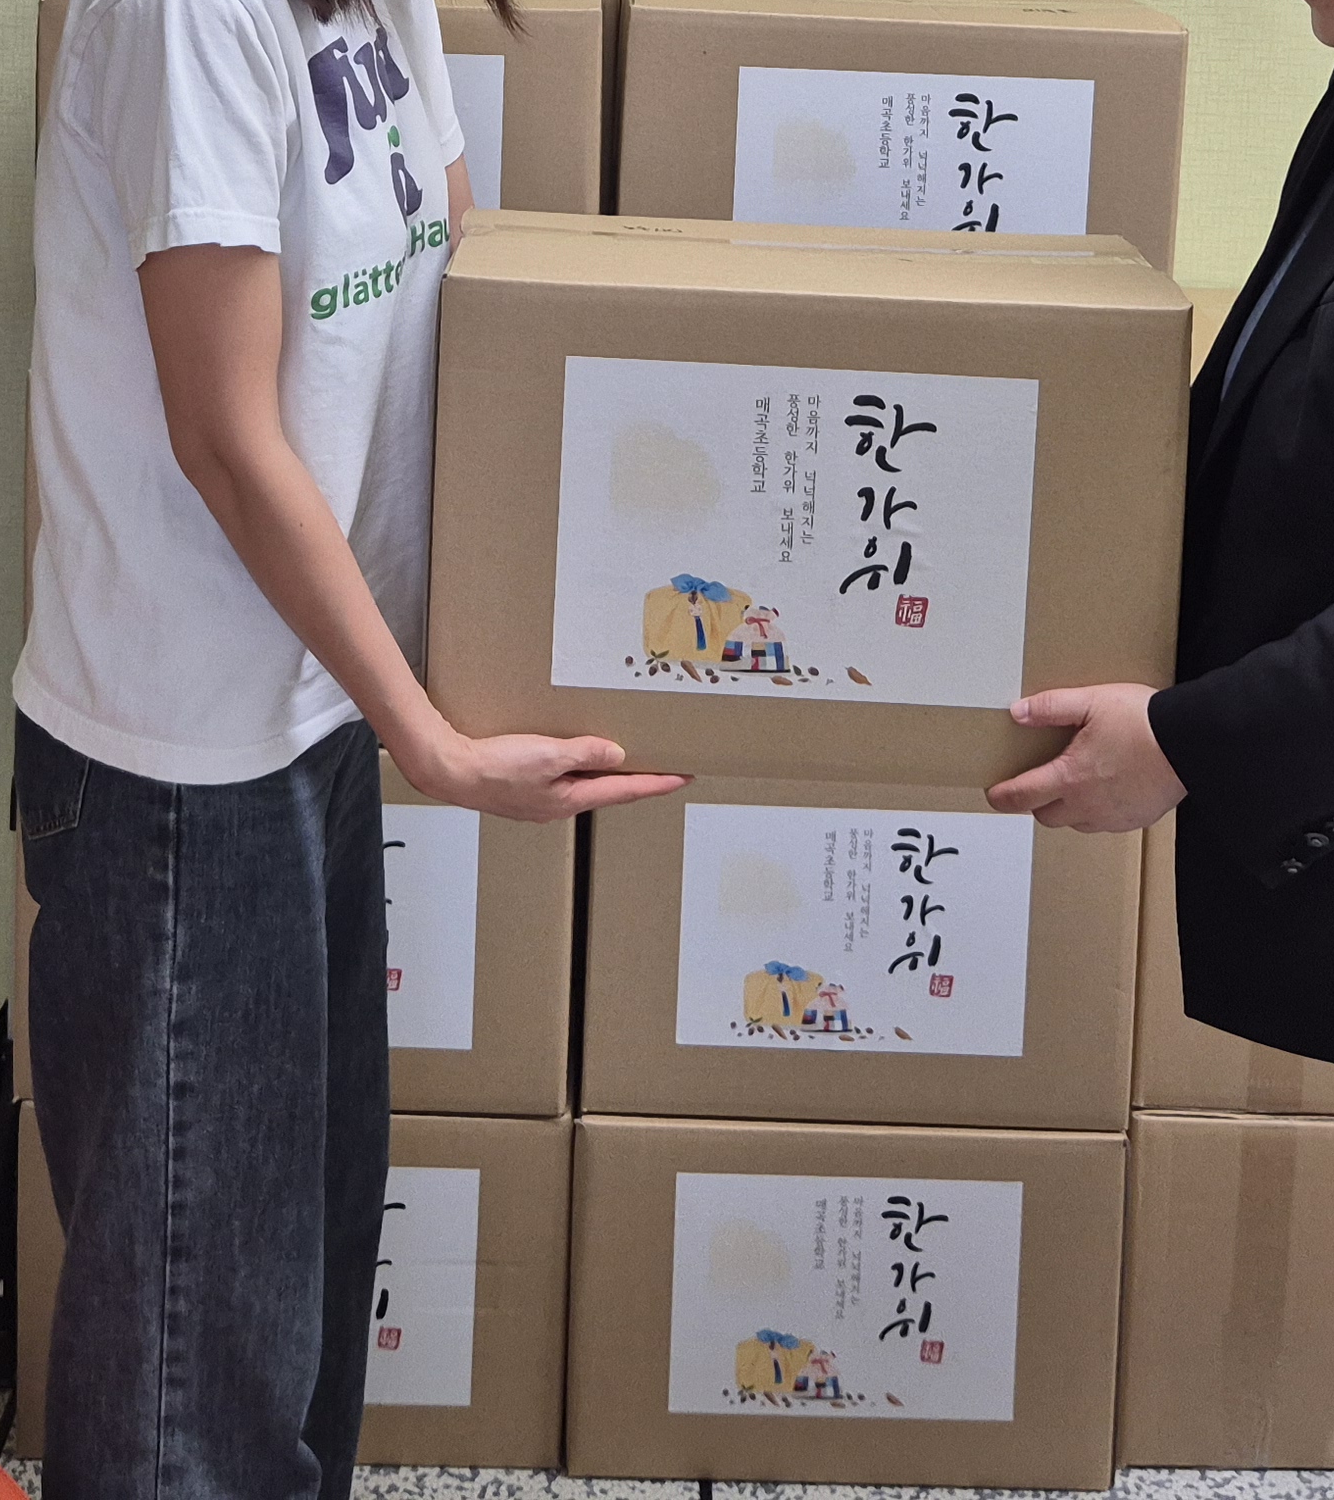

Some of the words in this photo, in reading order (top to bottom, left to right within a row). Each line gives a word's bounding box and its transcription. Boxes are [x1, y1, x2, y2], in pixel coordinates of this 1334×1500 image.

[878, 96, 893, 168] 매곡초등학교
[949, 93, 1018, 233] 한가위
[900, 180, 911, 221] 보내세요
[751, 397, 770, 493] 매곡초등학교
[786, 394, 800, 437] 풍성한
[806, 395, 821, 454] 마음까지
[783, 451, 797, 493] 한가위
[801, 470, 816, 545] 넉넉해지는
[839, 395, 937, 592] 한가위
[779, 508, 794, 562] 보내세요
[895, 594, 929, 628] 福
[888, 828, 959, 974] 한가위
[879, 1196, 948, 1340] 한가위
